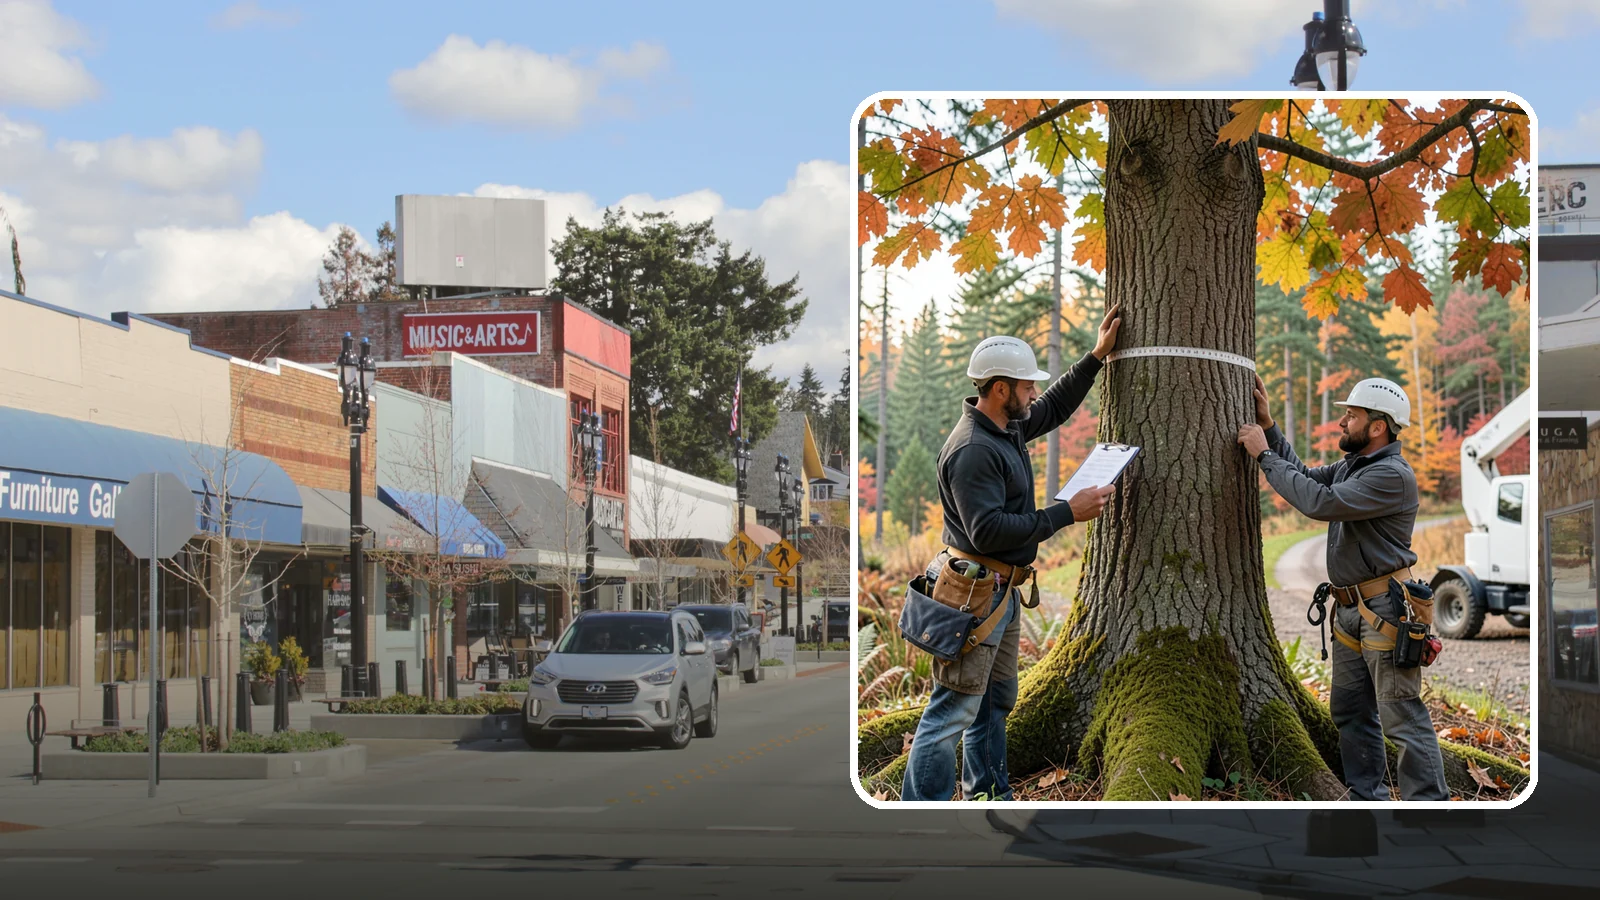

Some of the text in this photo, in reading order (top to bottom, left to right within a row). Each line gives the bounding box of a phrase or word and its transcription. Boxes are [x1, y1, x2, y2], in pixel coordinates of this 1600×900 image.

[1540, 427, 1577, 436] UGA
[0, 471, 79, 515] Furniture
[453, 563, 479, 574] SUSHI
